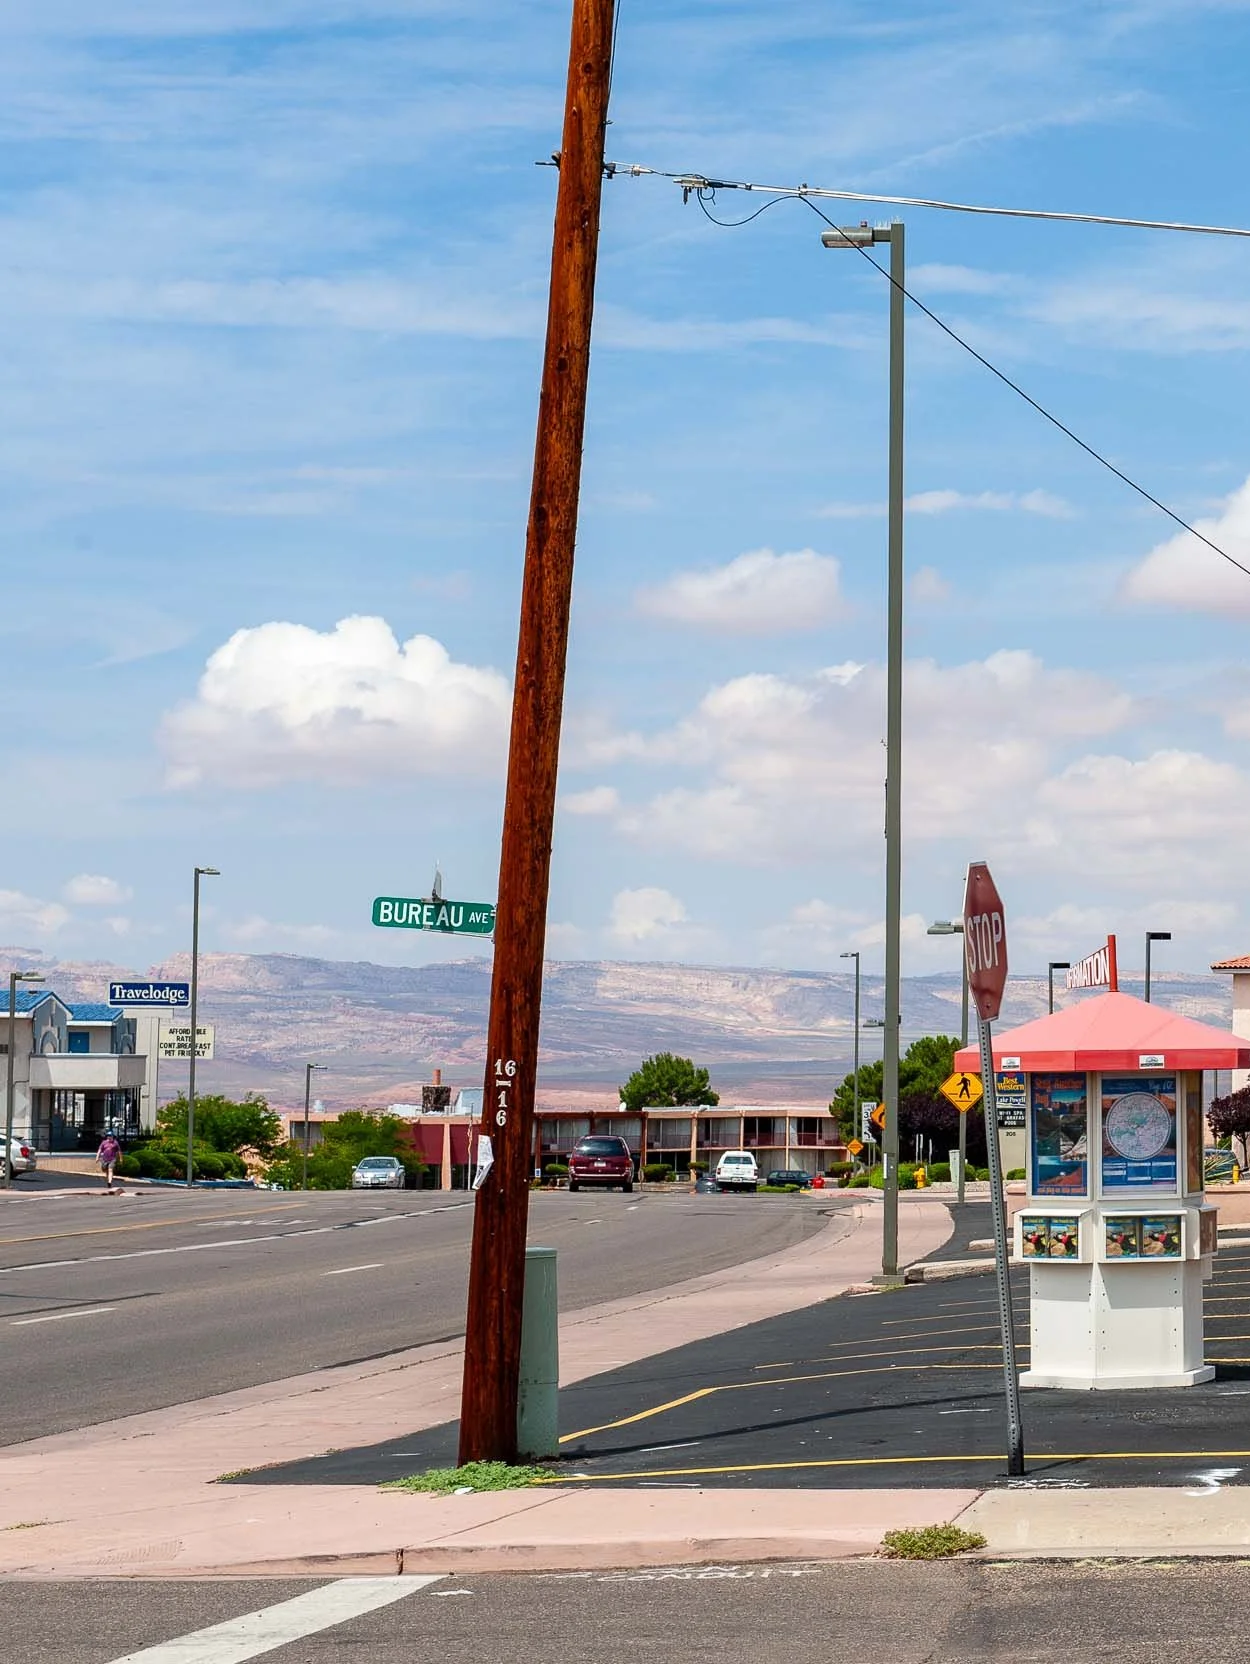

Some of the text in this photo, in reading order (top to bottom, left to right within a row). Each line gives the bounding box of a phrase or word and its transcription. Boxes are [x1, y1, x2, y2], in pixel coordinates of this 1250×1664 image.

[380, 901, 489, 928] BUREAU AVE
[967, 911, 1002, 973] STOP
[112, 984, 185, 1004] Travelodge
[169, 1027, 207, 1035] AFFORDBLE
[494, 1059, 516, 1077] 16
[997, 1082, 1025, 1091] Western
[1003, 1076, 1018, 1085] Best
[597, 1569, 822, 1582] CONDUIT
